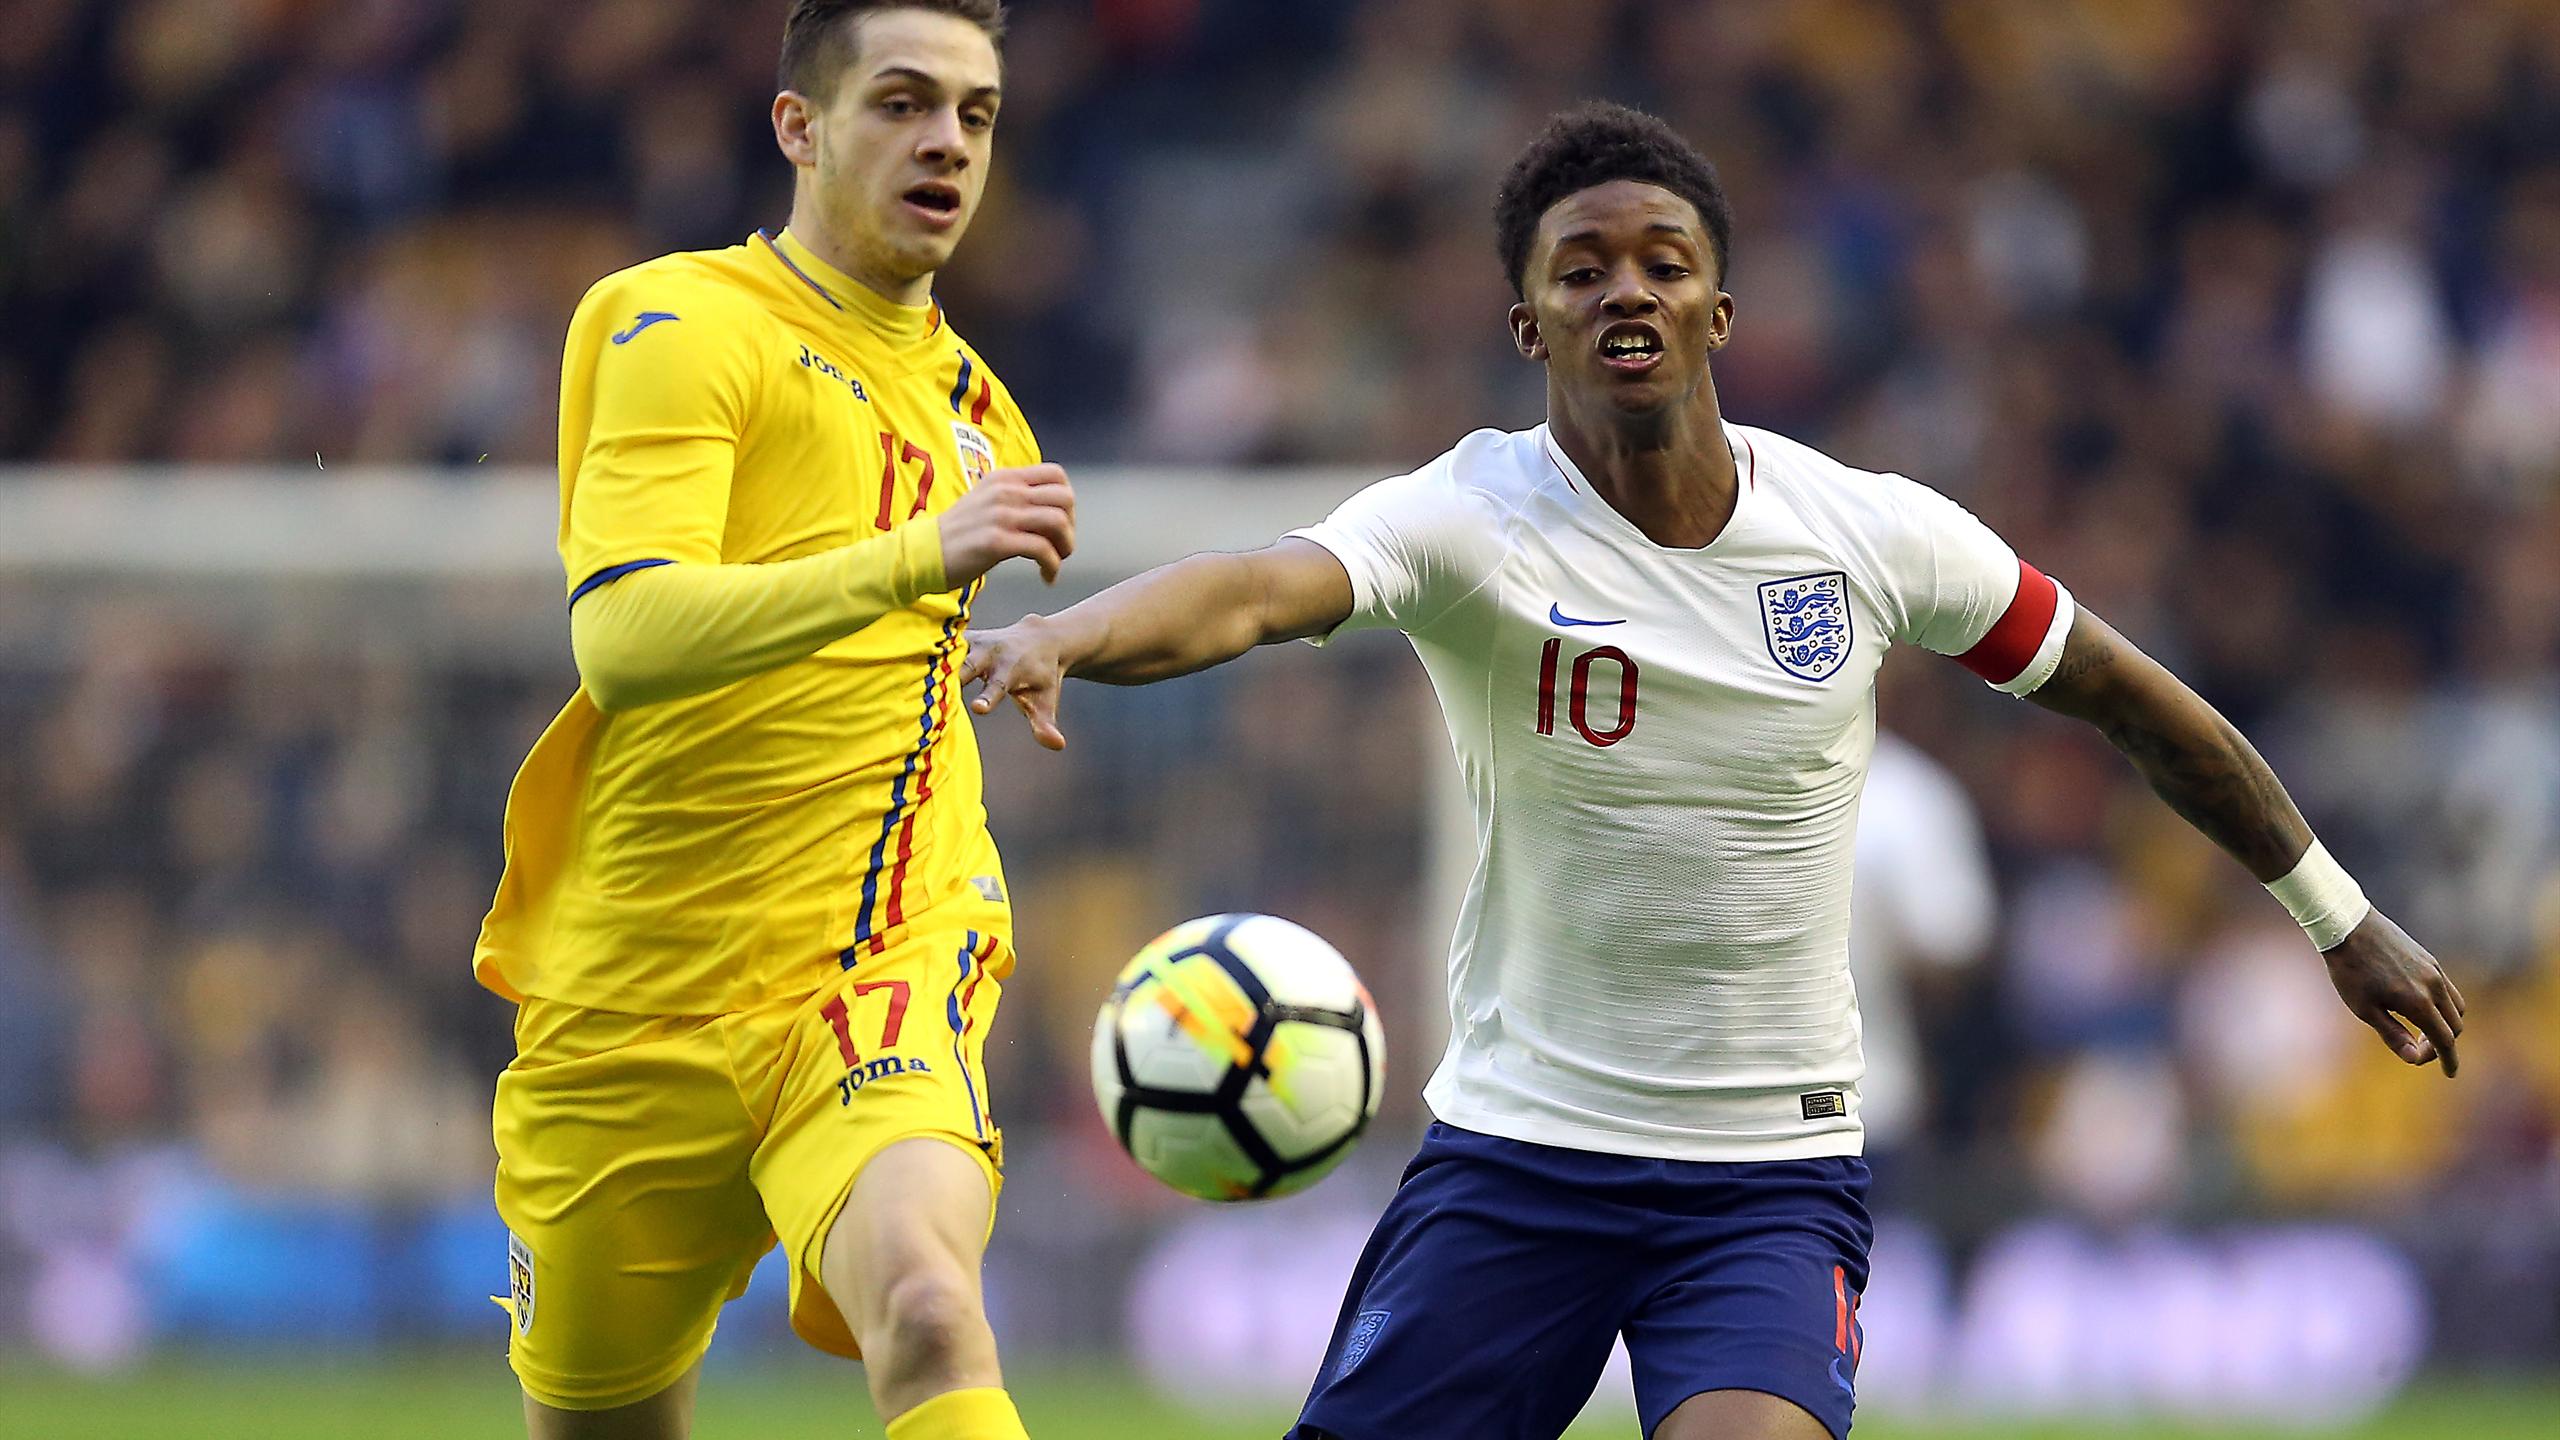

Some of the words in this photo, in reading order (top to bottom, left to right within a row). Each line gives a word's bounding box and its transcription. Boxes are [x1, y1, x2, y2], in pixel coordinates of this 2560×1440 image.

[874, 431, 934, 531] 17
[1535, 637, 1639, 747] 10
[819, 981, 911, 1068] 17
